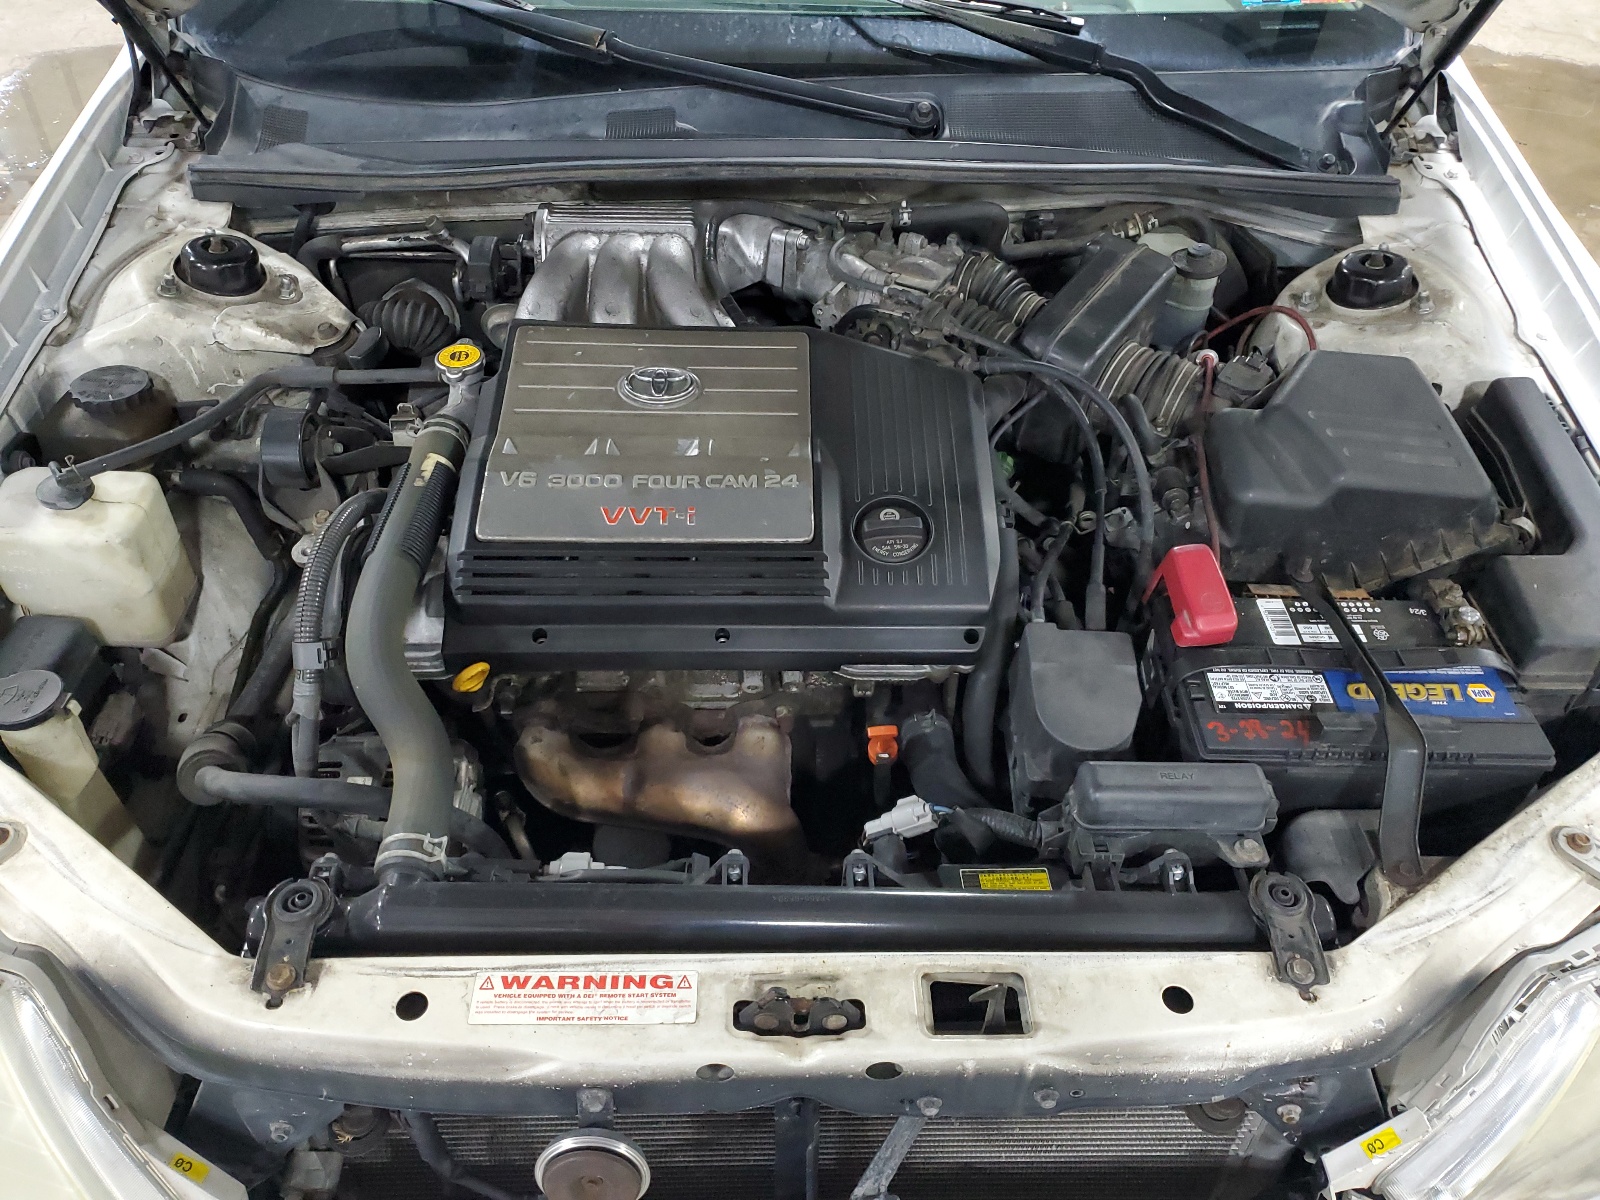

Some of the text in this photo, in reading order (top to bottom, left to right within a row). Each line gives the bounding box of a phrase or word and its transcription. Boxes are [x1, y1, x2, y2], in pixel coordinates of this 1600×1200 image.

[500, 471, 799, 489] V6 3000 FOUR CAM 24
[601, 506, 696, 525] VVT-i
[1409, 607, 1428, 616] 3/24
[1471, 689, 1493, 698] NAPA
[1159, 772, 1194, 780] RELAY
[501, 974, 674, 990] WARNING
